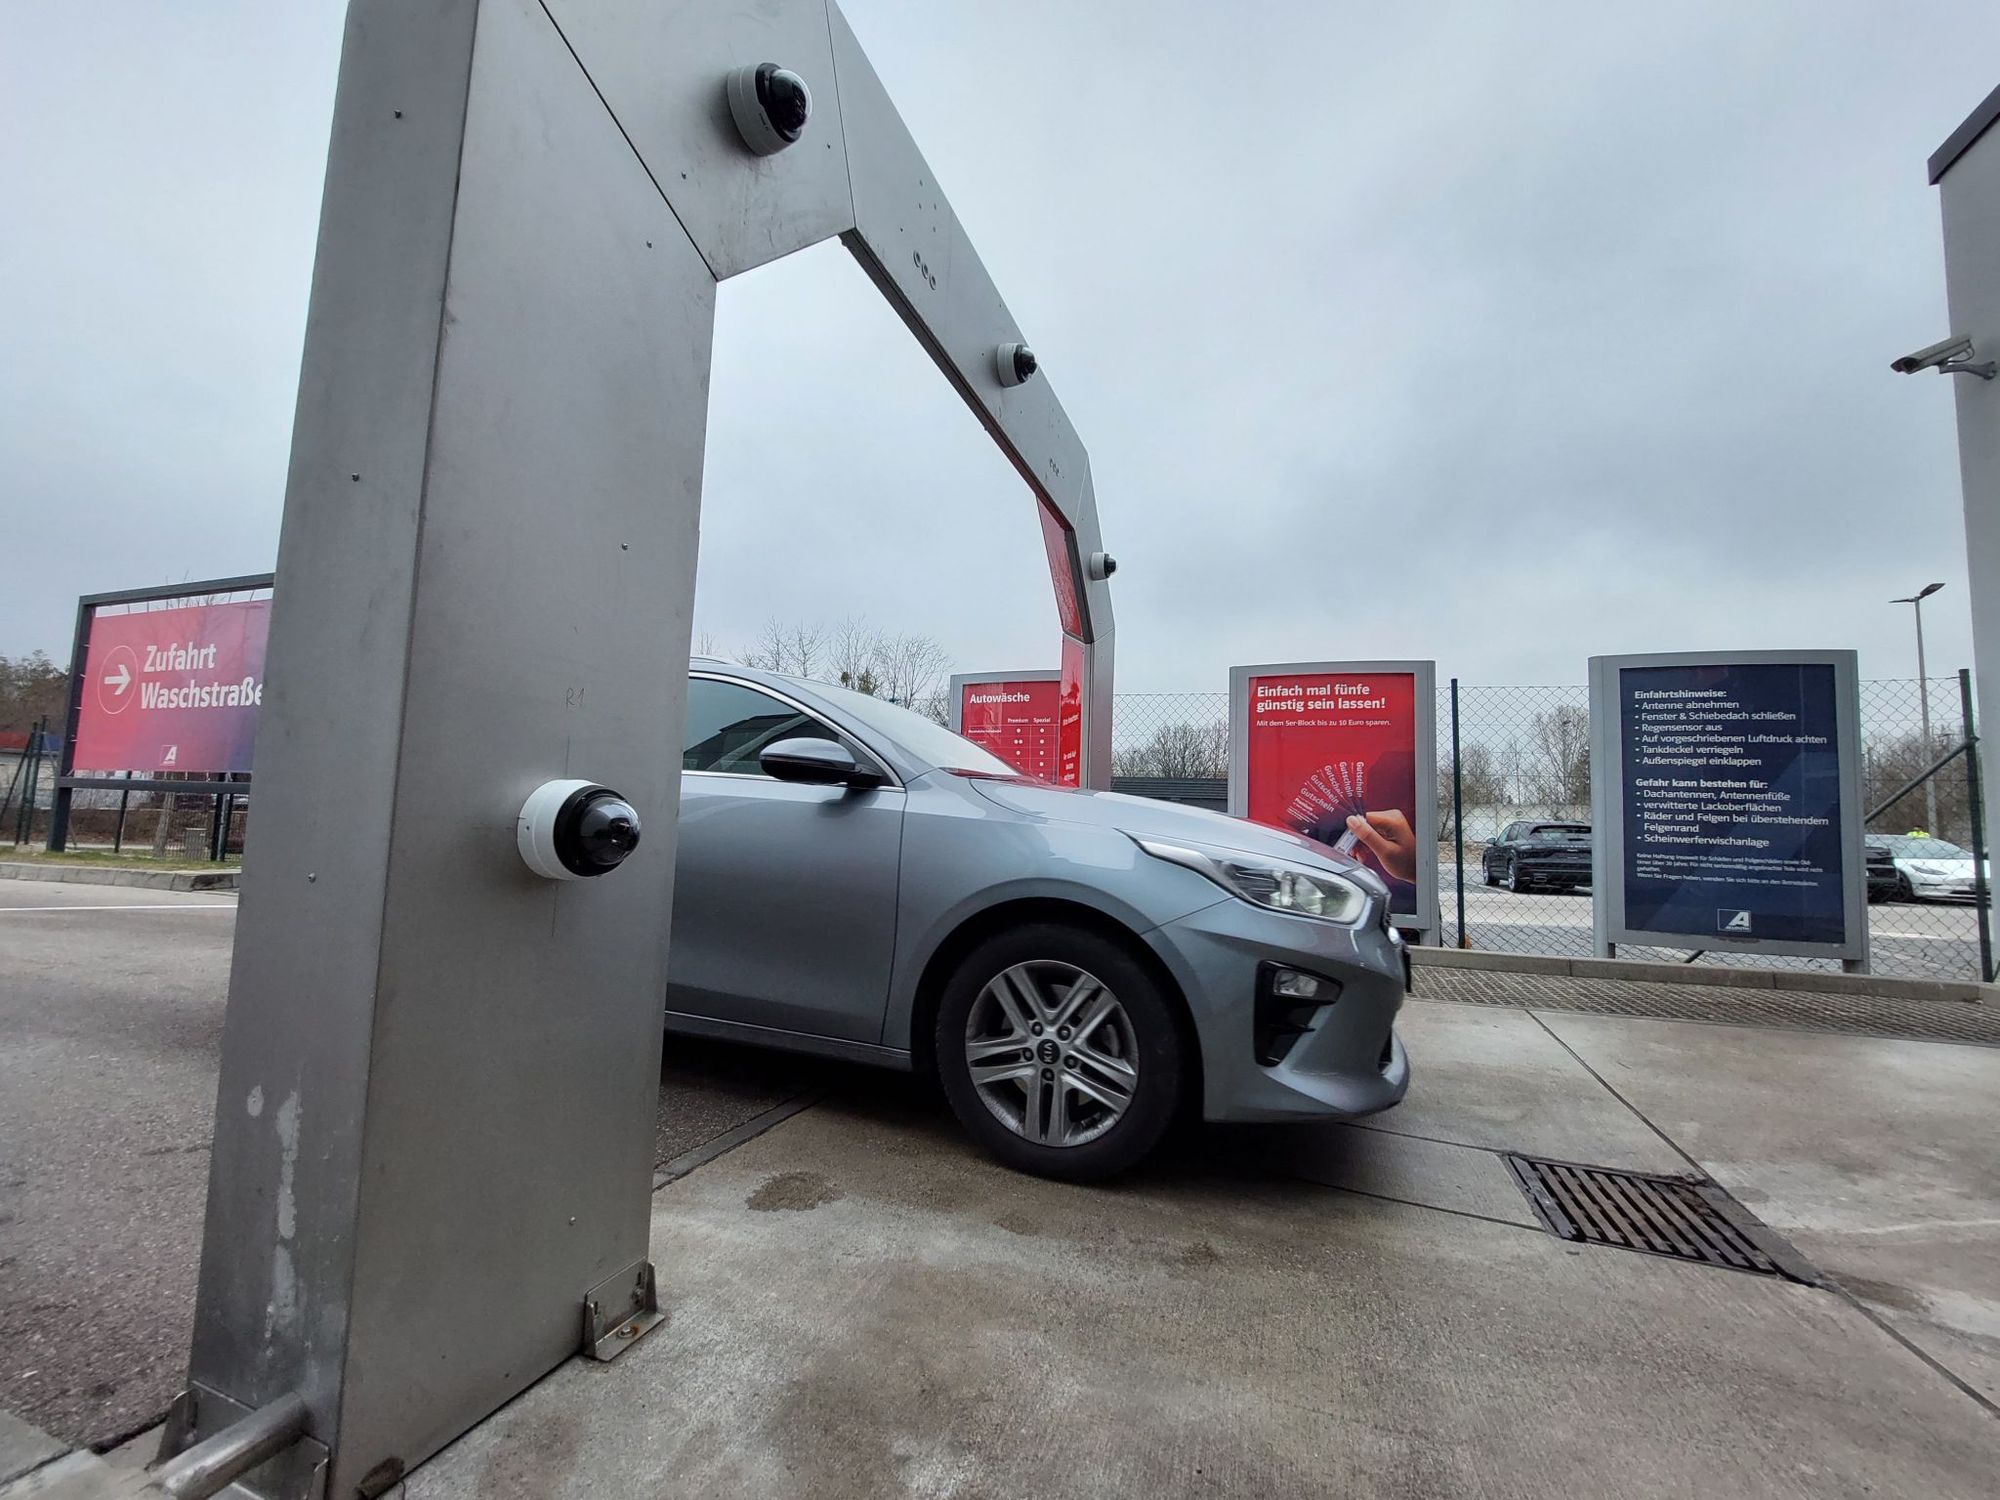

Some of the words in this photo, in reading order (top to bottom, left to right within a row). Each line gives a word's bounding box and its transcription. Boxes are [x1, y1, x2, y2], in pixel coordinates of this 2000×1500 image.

[144, 641, 216, 672] Zufahrt
[1258, 685, 1302, 697] Einfach
[1306, 684, 1330, 696] mal
[1334, 684, 1370, 695] fünfe
[1635, 690, 1727, 699] Einfahrtshinweise:
[970, 692, 1030, 704] Autowäsche
[1256, 699, 1304, 713] günstig
[1308, 698, 1334, 710] sein
[1338, 698, 1385, 709] lassen!
[1642, 702, 1684, 710] Antenne
[1686, 700, 1739, 709] abnehmen
[1642, 712, 1678, 720] Fenster
[1680, 712, 1687, 720] &
[1688, 712, 1749, 720] Schiebedach
[1751, 712, 1796, 720] schließen
[1642, 724, 1703, 733] Regensensor
[1642, 734, 1659, 742] Auf
[1660, 734, 1745, 744] vorgeschriebenen
[1748, 734, 1793, 743] Luftdruck
[1795, 735, 1827, 744] achten
[1641, 745, 1694, 754] Tankdeckel
[1696, 746, 1744, 756] verriegeln
[1642, 756, 1707, 767] Außenspiegel
[1709, 756, 1761, 767] einklappen
[1340, 762, 1353, 798] Gutschein
[1356, 762, 1364, 798] Gutschein
[1636, 778, 1670, 786] Gefahr
[1672, 778, 1698, 787] kann
[1700, 779, 1748, 788] bestehen
[1748, 780, 1768, 788] für:
[1310, 774, 1340, 804] Gutschein
[1300, 788, 1334, 812] Gutschein
[1644, 790, 1718, 800] Dachantennen,
[1719, 791, 1790, 800] Antennenfüße
[1643, 801, 1699, 810] verwitterte
[1701, 802, 1782, 812] Lackoberflächen
[1644, 811, 1673, 820] Räder
[1675, 813, 1696, 821] und
[1697, 813, 1730, 824] Felgen
[1732, 814, 1748, 823] bei
[1751, 814, 1829, 825] überstehendem
[1644, 823, 1700, 833] Felgenrand
[1644, 834, 1770, 848] Scheinwerferwischanlage
